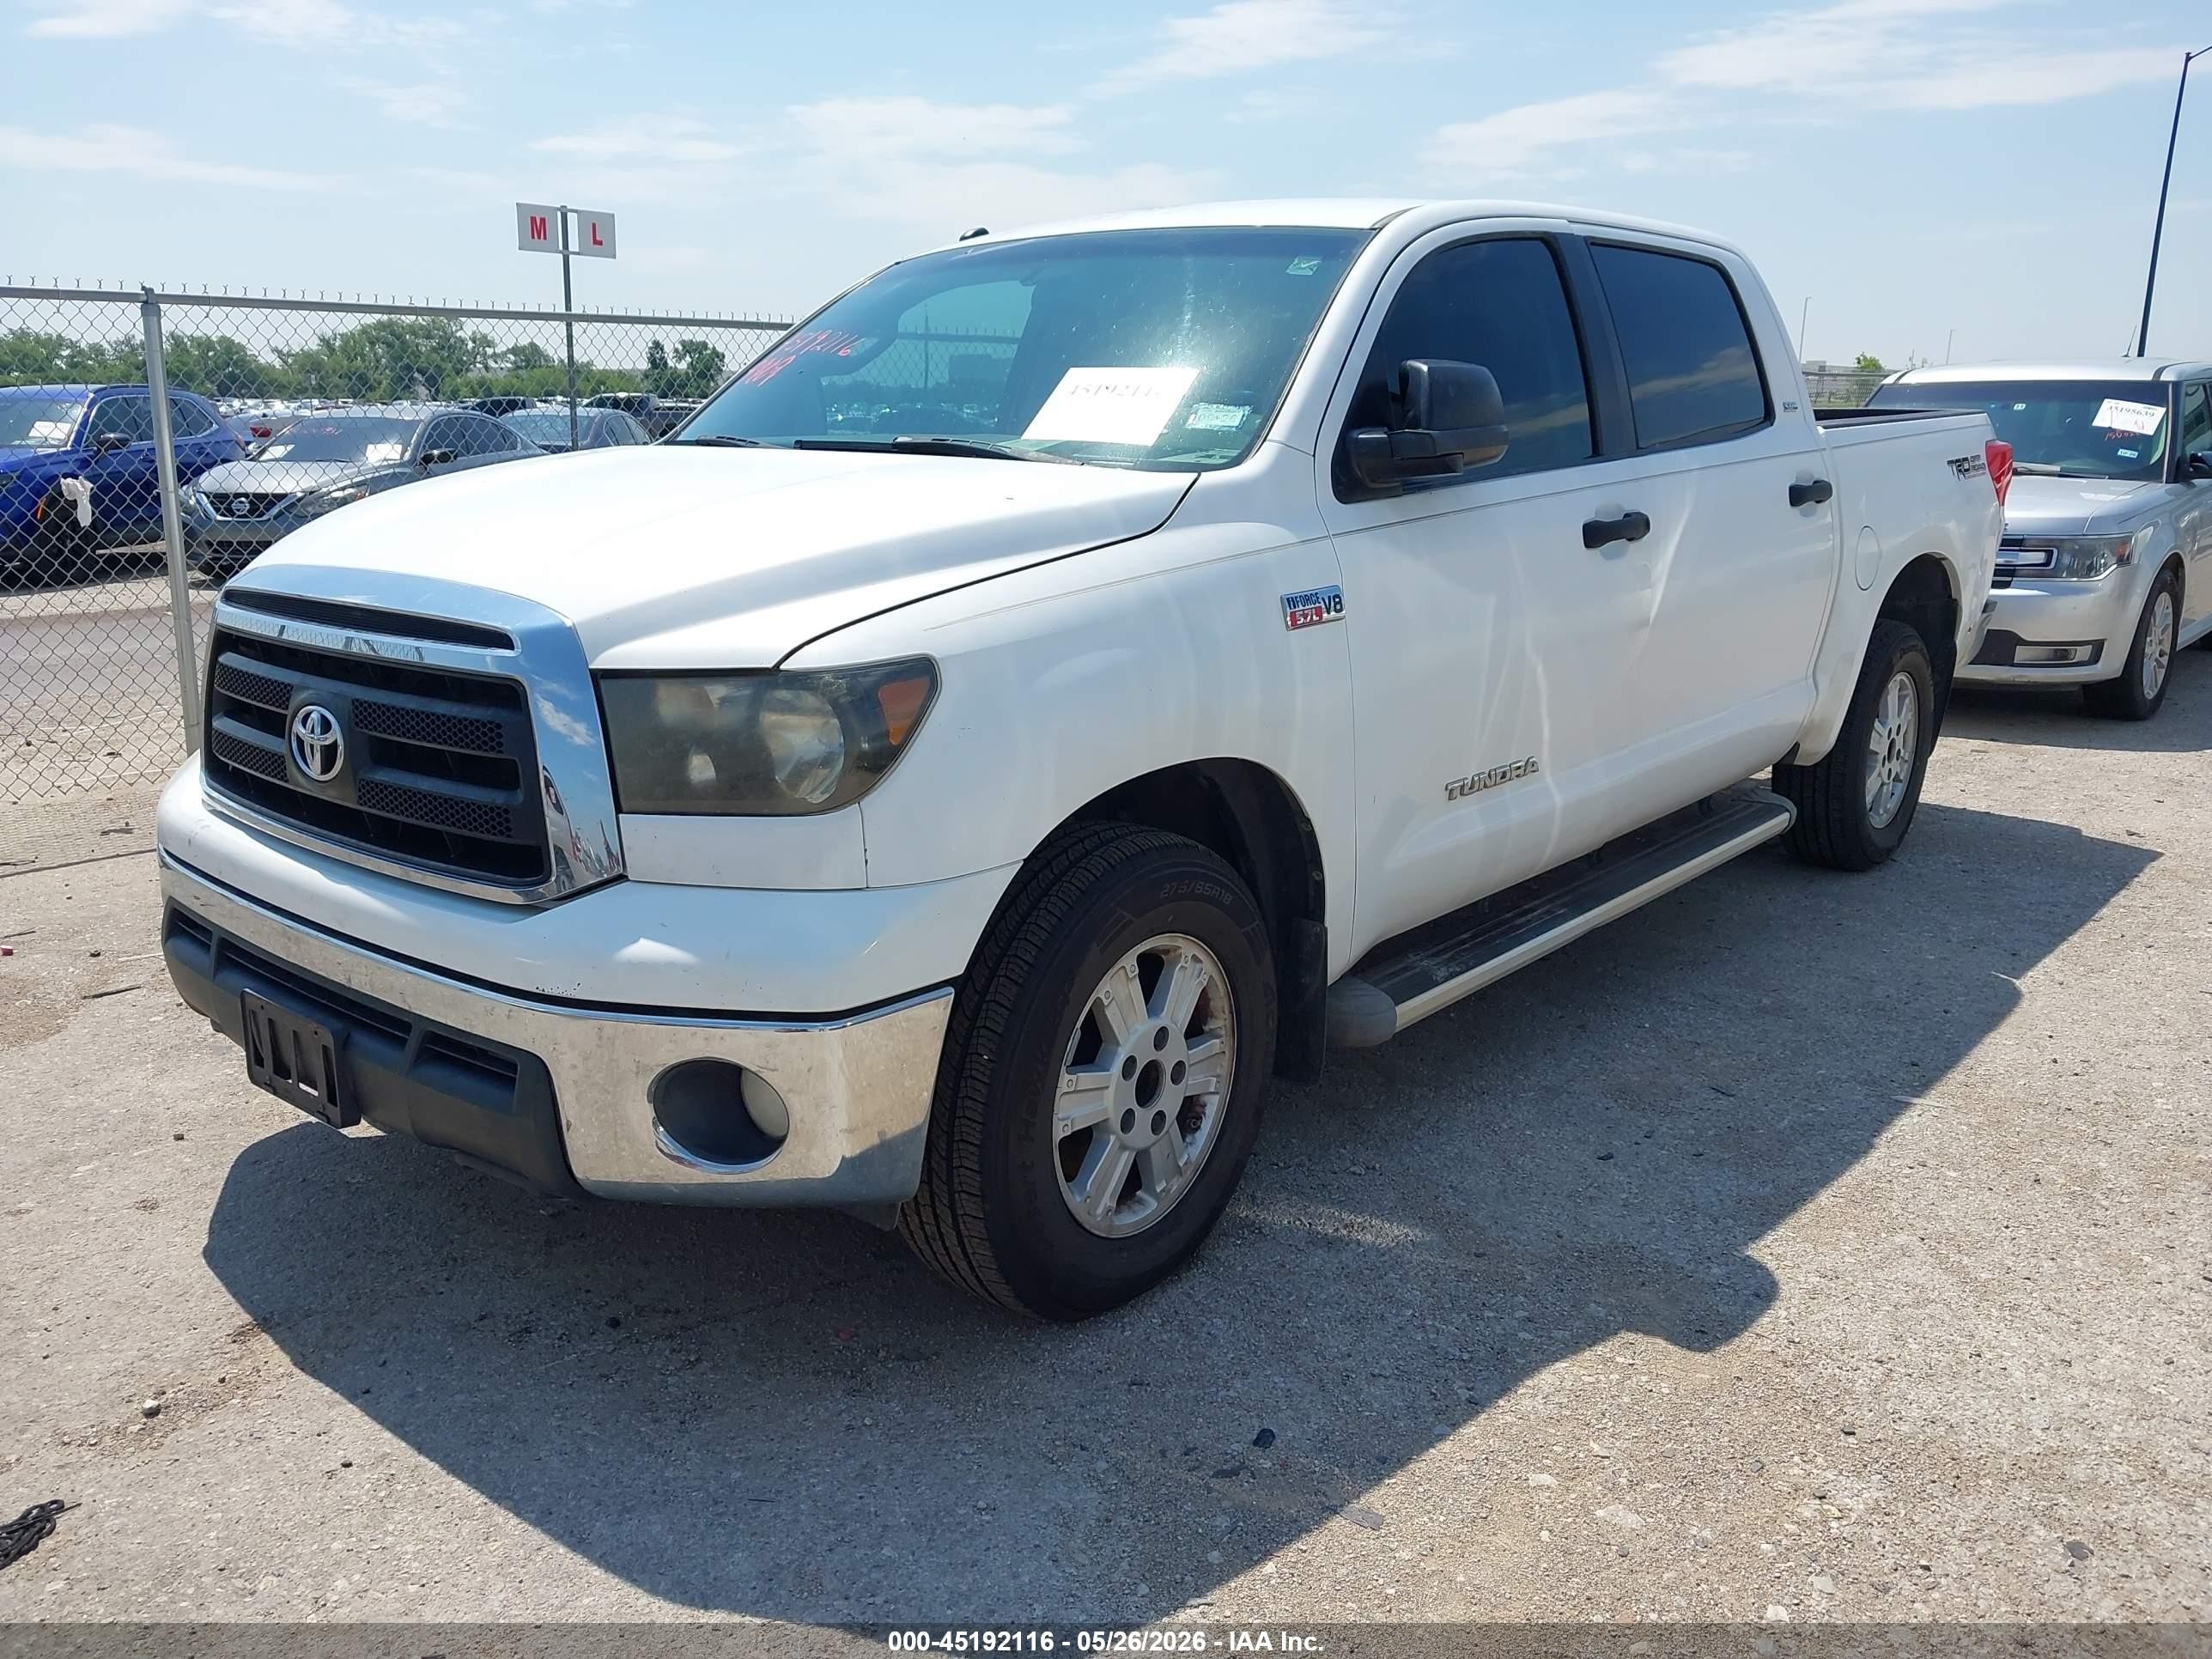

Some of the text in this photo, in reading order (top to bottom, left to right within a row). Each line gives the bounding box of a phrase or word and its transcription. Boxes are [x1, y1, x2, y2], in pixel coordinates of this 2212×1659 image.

[530, 216, 547, 240] M
[591, 222, 604, 246] L
[1947, 456, 1970, 481] TRD
[1322, 593, 1344, 615] V8
[1444, 755, 1540, 801] TUNDRA
